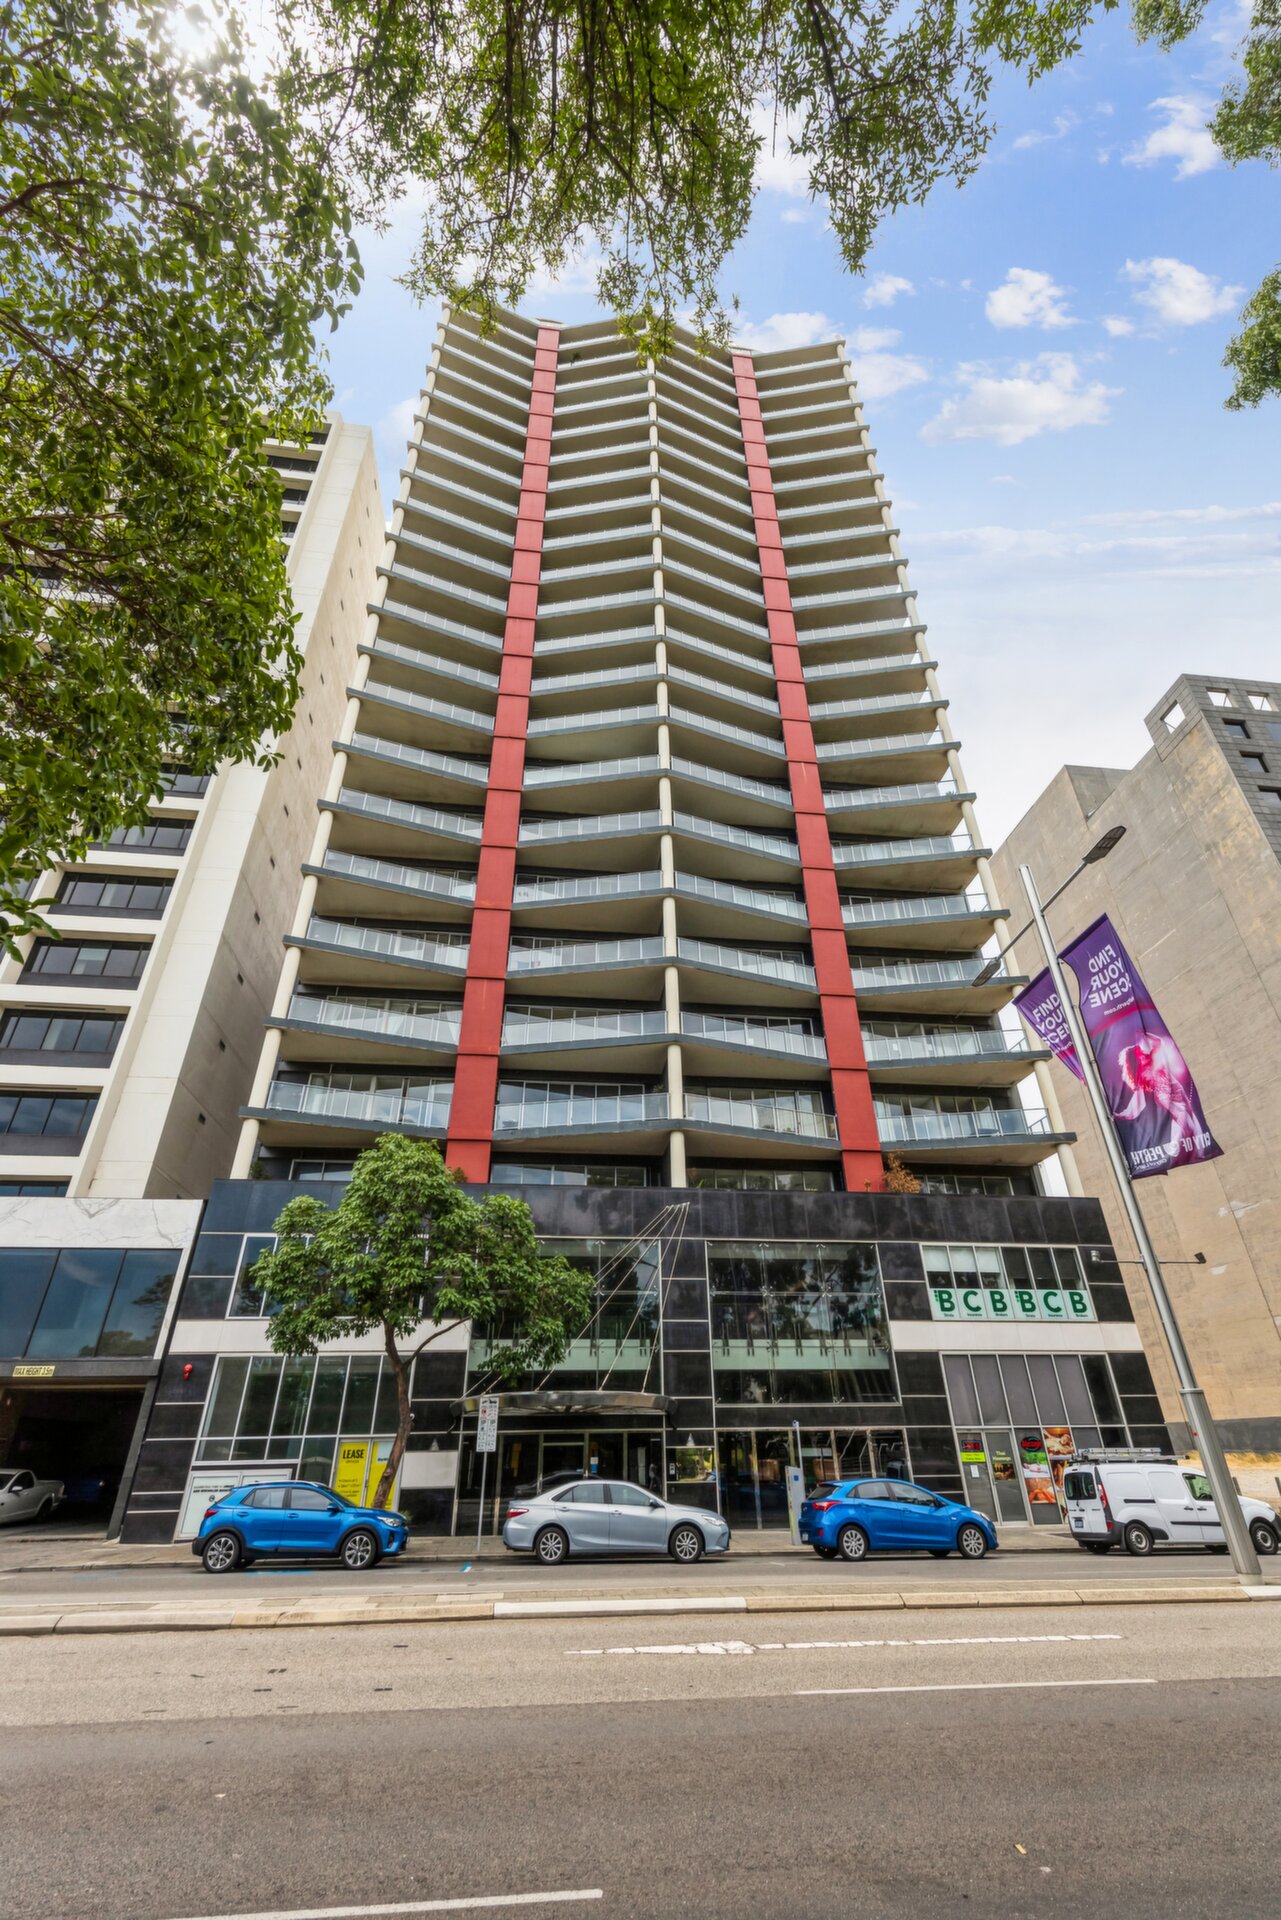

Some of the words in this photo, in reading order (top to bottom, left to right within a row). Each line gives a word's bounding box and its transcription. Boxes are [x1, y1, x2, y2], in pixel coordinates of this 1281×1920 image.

[1032, 993, 1060, 1022] FIND
[1036, 1006, 1066, 1034] YOU
[14, 1367, 26, 1376] MAX
[25, 1367, 42, 1376] HEIGHT
[342, 1449, 365, 1460] LEASE
